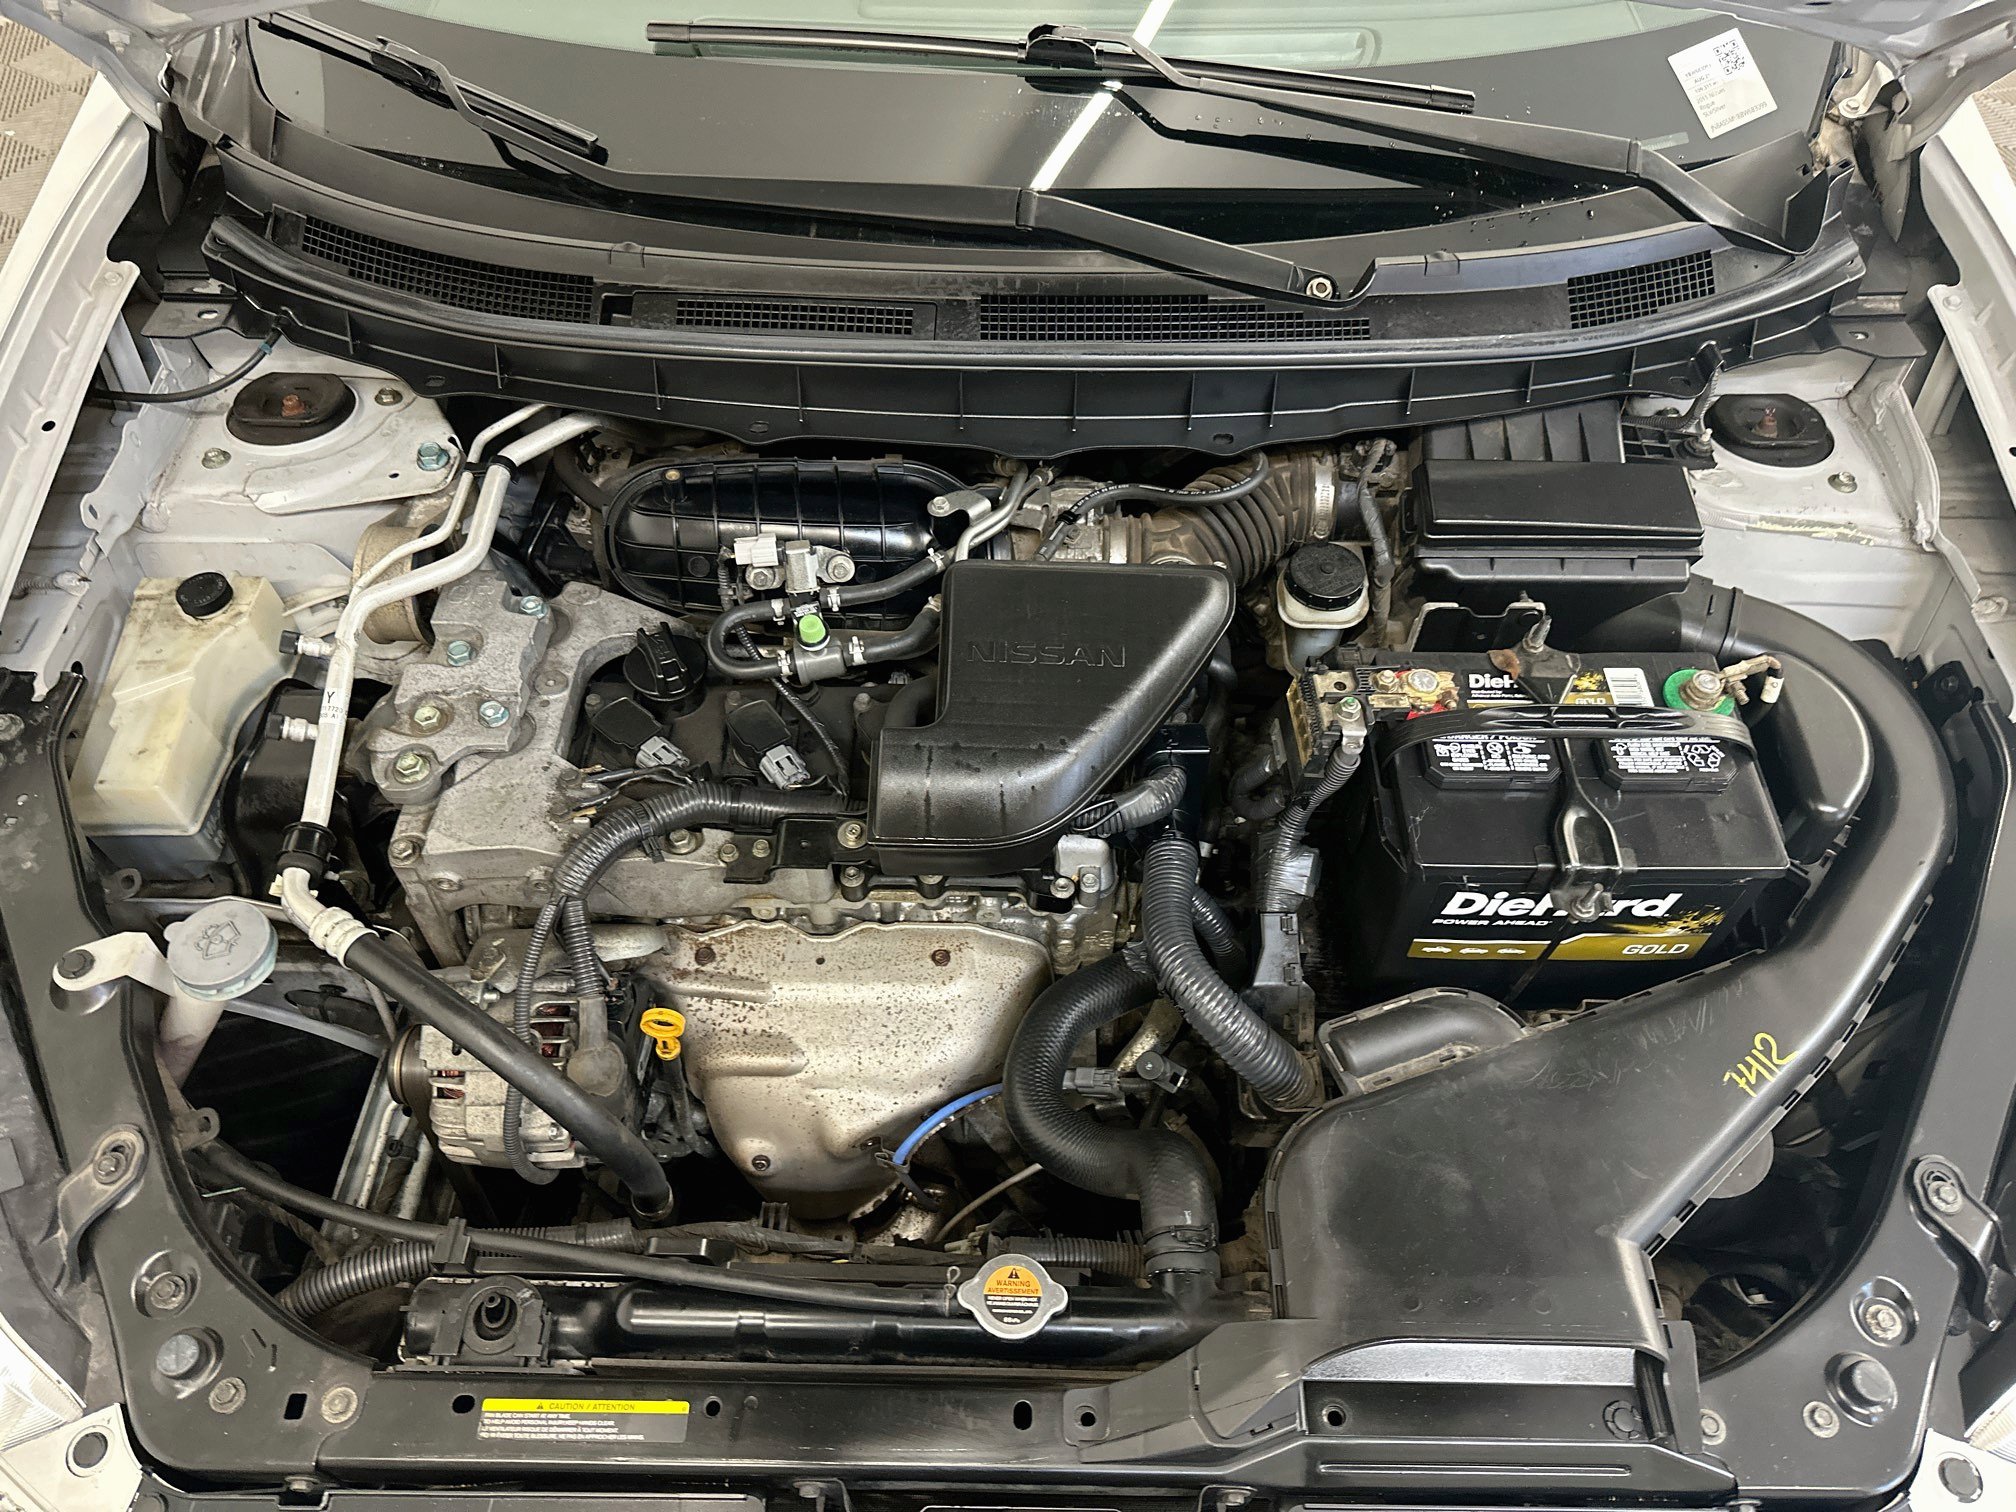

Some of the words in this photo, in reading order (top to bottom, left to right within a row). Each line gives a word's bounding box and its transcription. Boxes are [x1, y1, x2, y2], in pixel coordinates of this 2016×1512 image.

[967, 641, 1126, 667] NISSAN
[327, 691, 335, 703] Y
[1440, 891, 1682, 917] DieHrd
[1432, 918, 1490, 926] POWER
[1622, 943, 1690, 956] GOLD
[1722, 1032, 1801, 1098] 7412
[988, 1287, 1038, 1295] AVERTISSEMENT
[592, 1403, 635, 1411] ATTENTION
